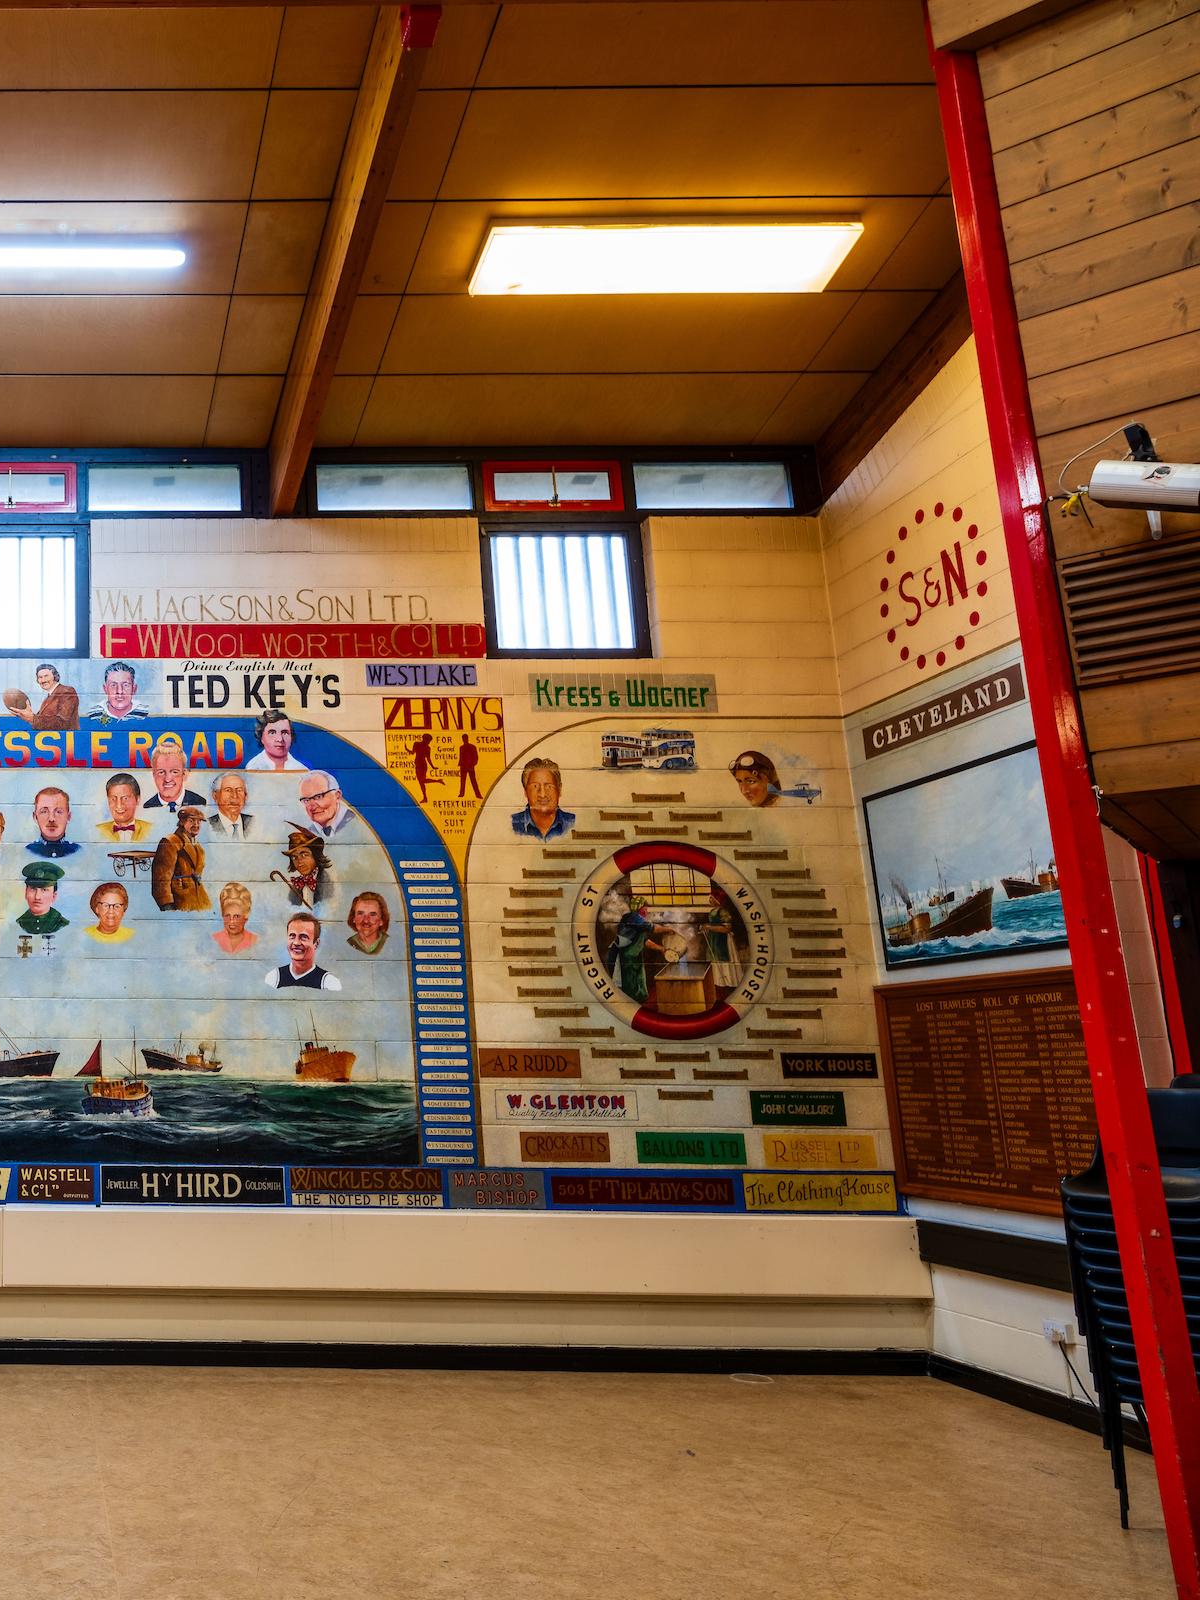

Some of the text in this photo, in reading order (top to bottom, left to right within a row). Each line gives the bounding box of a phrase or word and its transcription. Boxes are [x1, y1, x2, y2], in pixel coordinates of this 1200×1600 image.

[898, 541, 969, 628] S&N
[181, 660, 313, 673] Prime English Meat
[367, 664, 477, 686] WESTLAKE
[166, 674, 341, 709] TED KEY'S
[872, 677, 1011, 750] CLEVELAND
[444, 819, 464, 827] SUIT
[983, 997, 1003, 1007] ROLL
[1008, 995, 1020, 1005] OF
[1025, 991, 1063, 1004] HONOUR
[524, 1055, 568, 1073] RUDD
[786, 1059, 873, 1073] YORK HOUSE
[530, 1094, 625, 1110] GLENTON
[712, 1141, 739, 1158] LTD
[21, 1168, 91, 1182] WAISTELL
[291, 1168, 386, 1191] WINCKLES
[454, 1173, 525, 1188] MARCUS
[177, 1173, 243, 1199] HIRD
[245, 1180, 282, 1191] GOLDSMITH
[746, 1178, 891, 1205] The Clothing House
[296, 1194, 438, 1206] THE NOTED PIE SHOP
[476, 1190, 538, 1206] BISHOP
